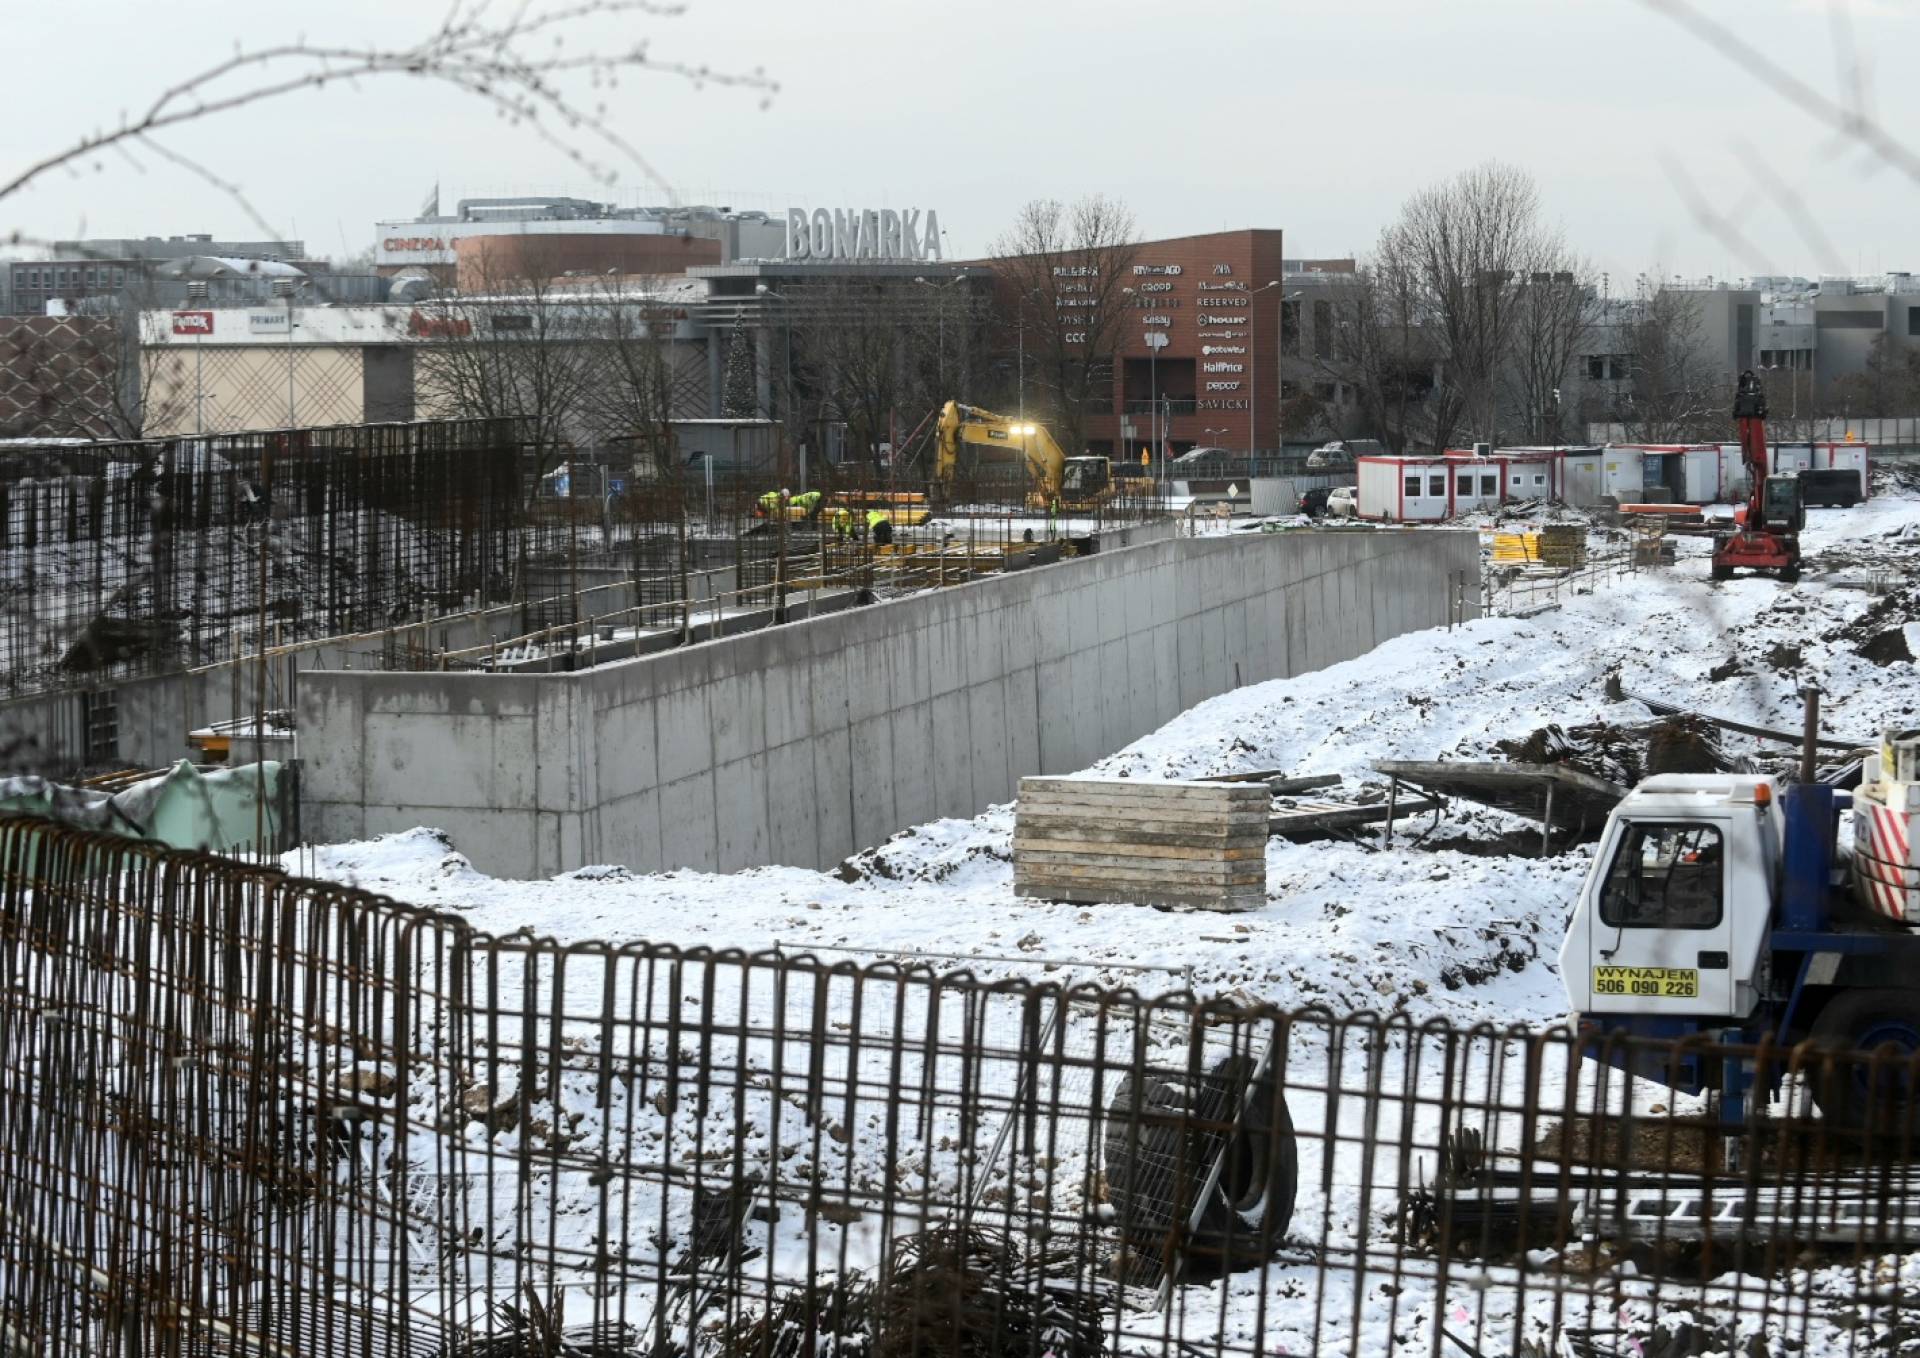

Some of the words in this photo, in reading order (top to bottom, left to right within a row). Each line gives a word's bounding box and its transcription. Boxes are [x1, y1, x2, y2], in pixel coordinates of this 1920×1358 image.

[787, 207, 942, 260] BONARKA
[383, 237, 445, 252] CINEMA
[1141, 283, 1172, 292] CROPP
[1196, 297, 1247, 306] RESERVED
[250, 315, 285, 324] PRIMARK
[1065, 333, 1086, 343] CCC
[1203, 362, 1243, 373] HalfPrice
[1198, 399, 1248, 409] SAVICKI
[1597, 967, 1694, 980] WYNAJEM
[1596, 979, 1625, 993] 506
[1631, 980, 1659, 994] 090
[1665, 982, 1694, 995] 226
